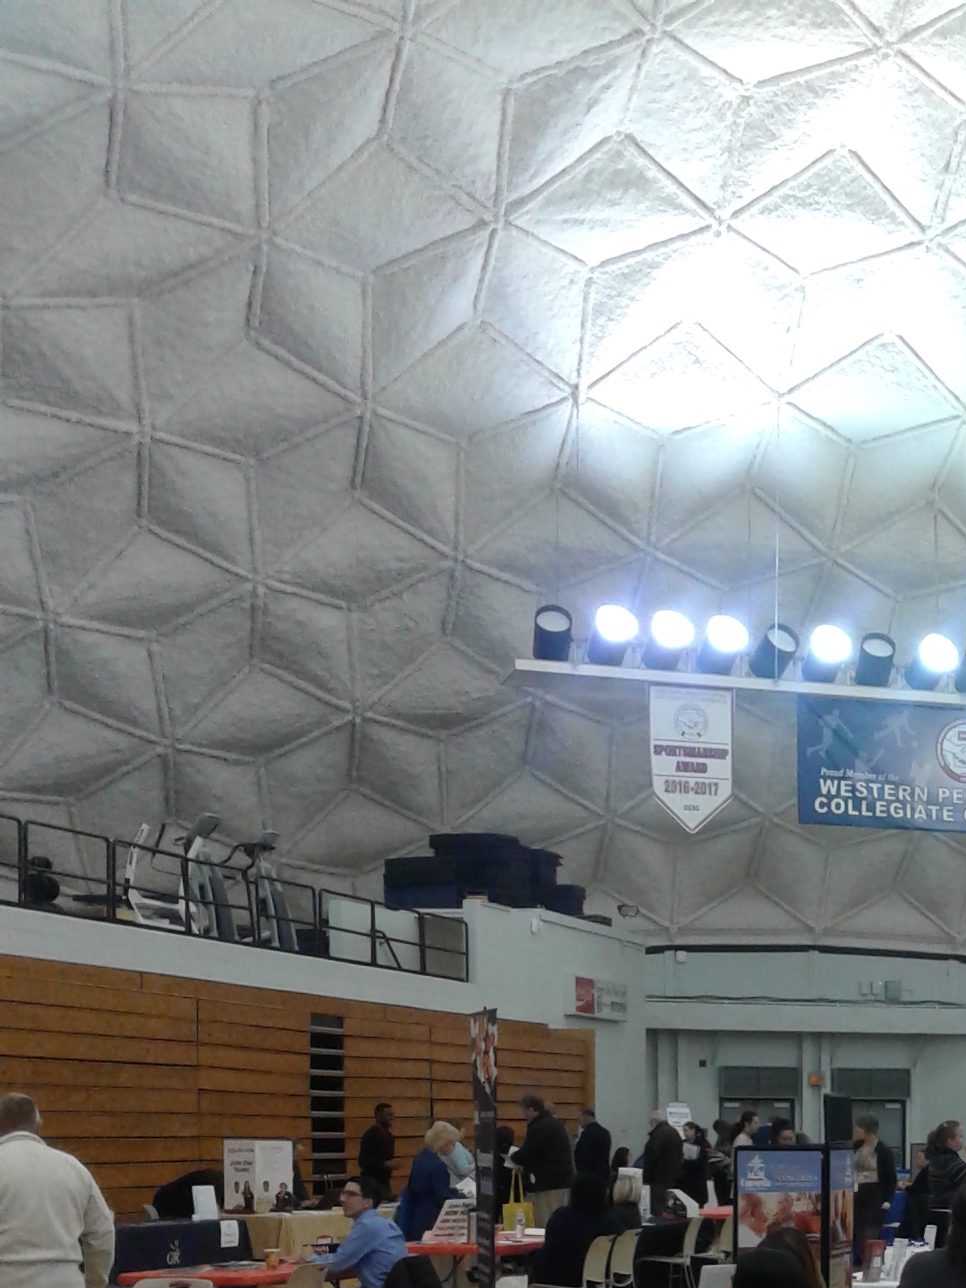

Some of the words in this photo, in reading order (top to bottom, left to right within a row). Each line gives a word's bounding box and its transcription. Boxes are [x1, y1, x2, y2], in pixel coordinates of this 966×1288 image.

[653, 744, 730, 760] SPORTSMANSHIP
[675, 760, 708, 774] AWARD
[663, 780, 719, 796] 2016-2017
[819, 778, 928, 802] WESTERN
[814, 796, 955, 822] COLLEGIATE
